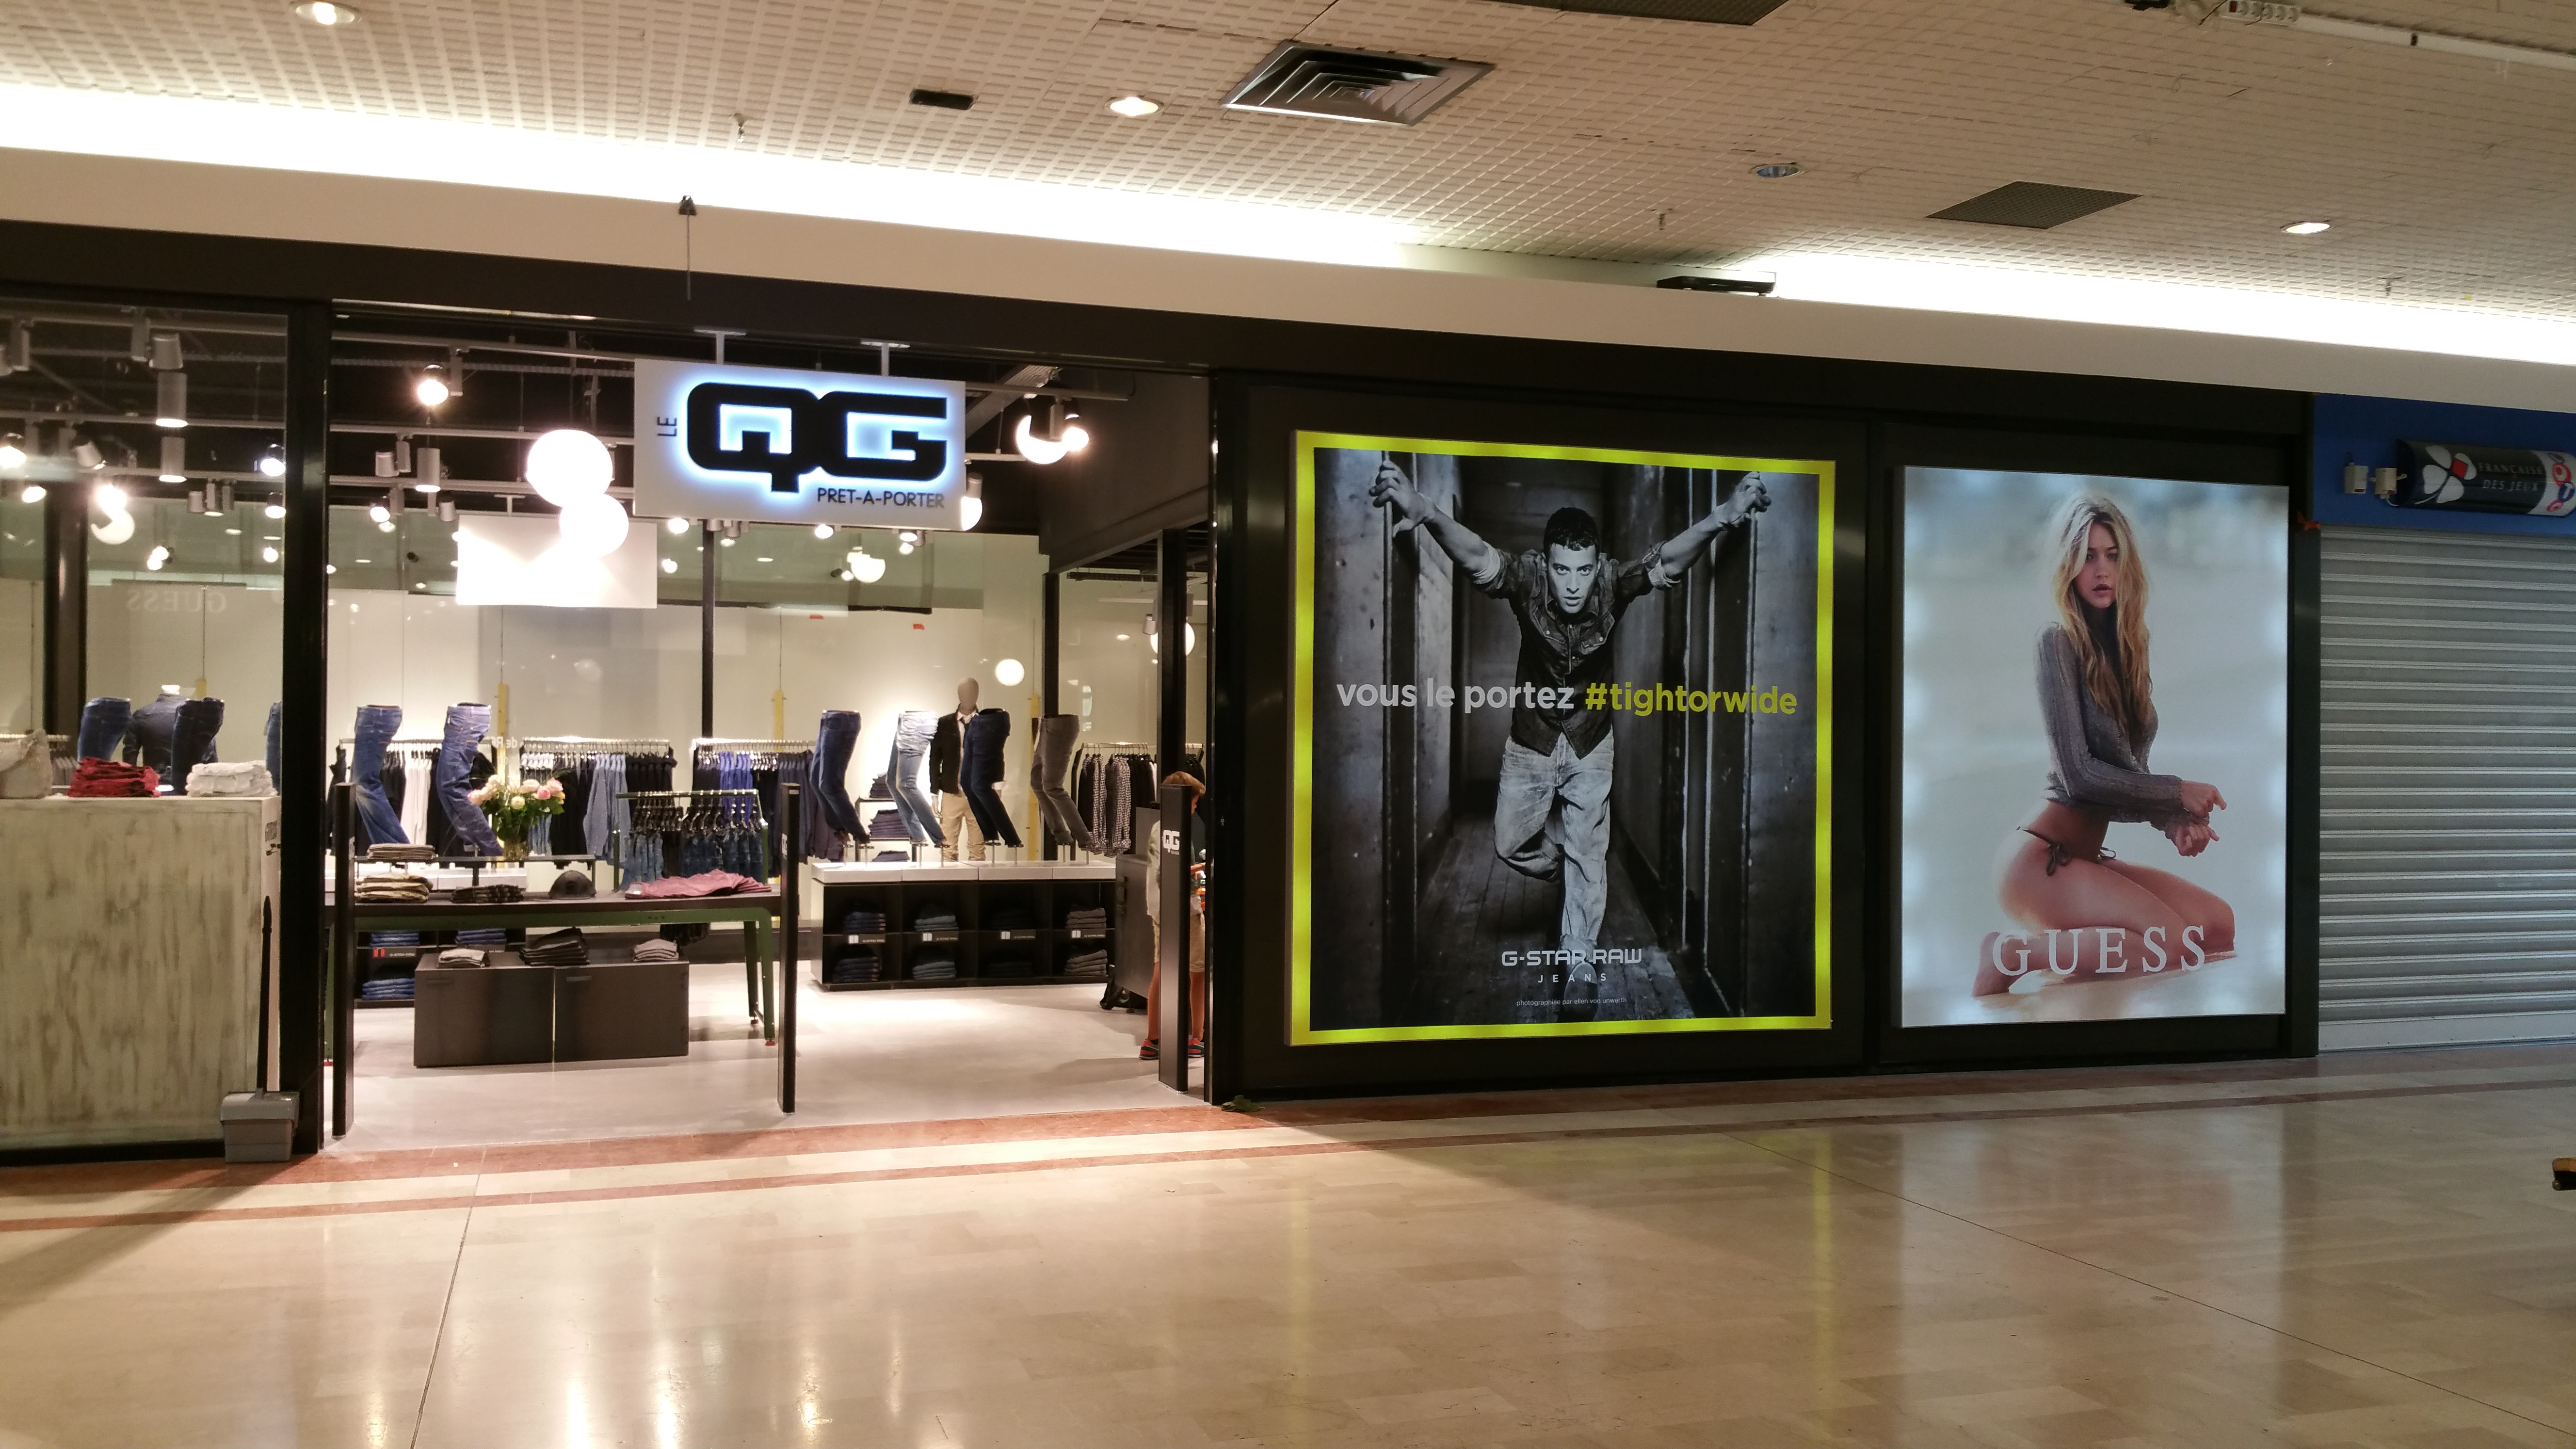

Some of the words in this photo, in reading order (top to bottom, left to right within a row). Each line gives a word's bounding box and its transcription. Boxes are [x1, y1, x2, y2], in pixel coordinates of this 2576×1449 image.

[657, 416, 677, 437] LE
[687, 382, 947, 493] QG
[2482, 479, 2505, 489] DES
[2509, 481, 2539, 492] JEUX
[818, 488, 945, 508] PRET-A-PORTER
[1336, 683, 1417, 707] vous
[1427, 678, 1455, 708] le
[1465, 681, 1575, 714] portez
[1585, 681, 1797, 717] #tightorwide
[1163, 829, 1180, 853] QG
[1502, 950, 1587, 966] G-STAR
[1593, 949, 1642, 965] RAW
[1992, 925, 2206, 976] GUESS
[1538, 973, 1607, 983] JEANS
